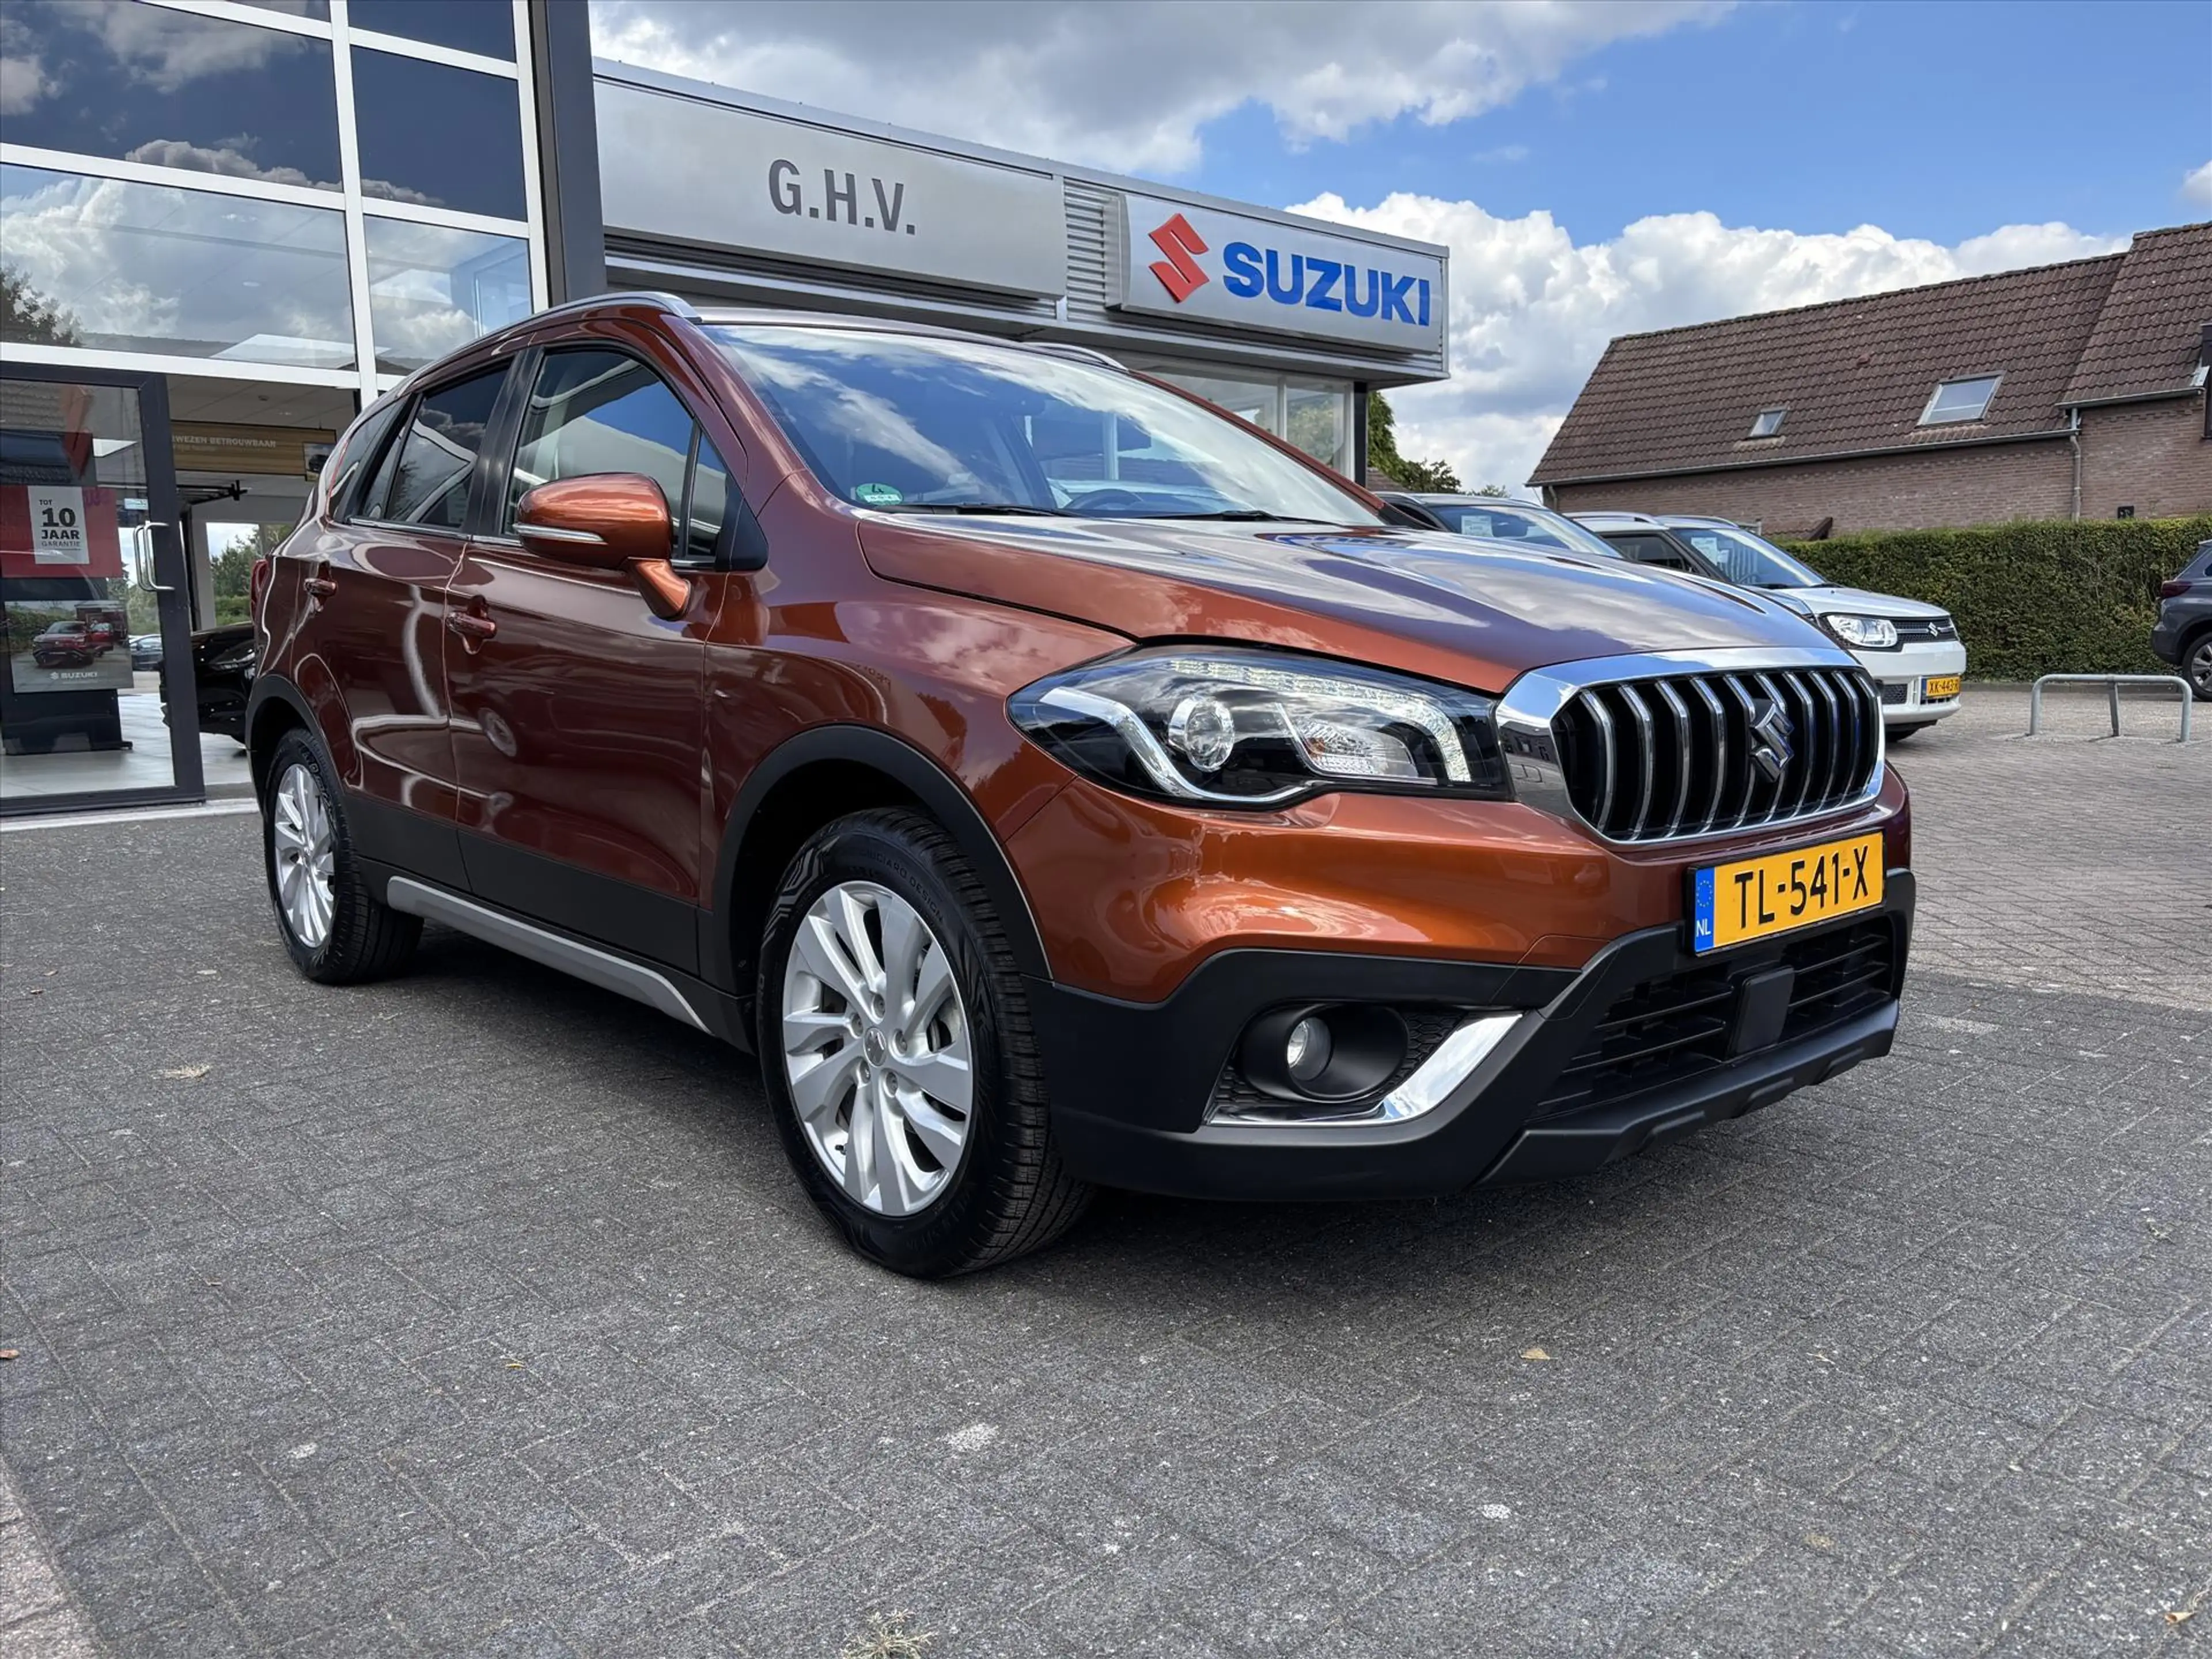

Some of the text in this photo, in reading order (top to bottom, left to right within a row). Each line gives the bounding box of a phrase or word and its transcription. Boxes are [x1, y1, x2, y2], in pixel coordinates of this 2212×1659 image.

[768, 158, 916, 236] G.H.V.
[1223, 241, 1431, 327] SUZUKI
[210, 437, 276, 448] BETROUWBAAR
[42, 507, 76, 527] 10
[41, 529, 80, 540] JAAR
[1734, 845, 1869, 930] TL-541-X
[1695, 918, 1711, 938] NL
